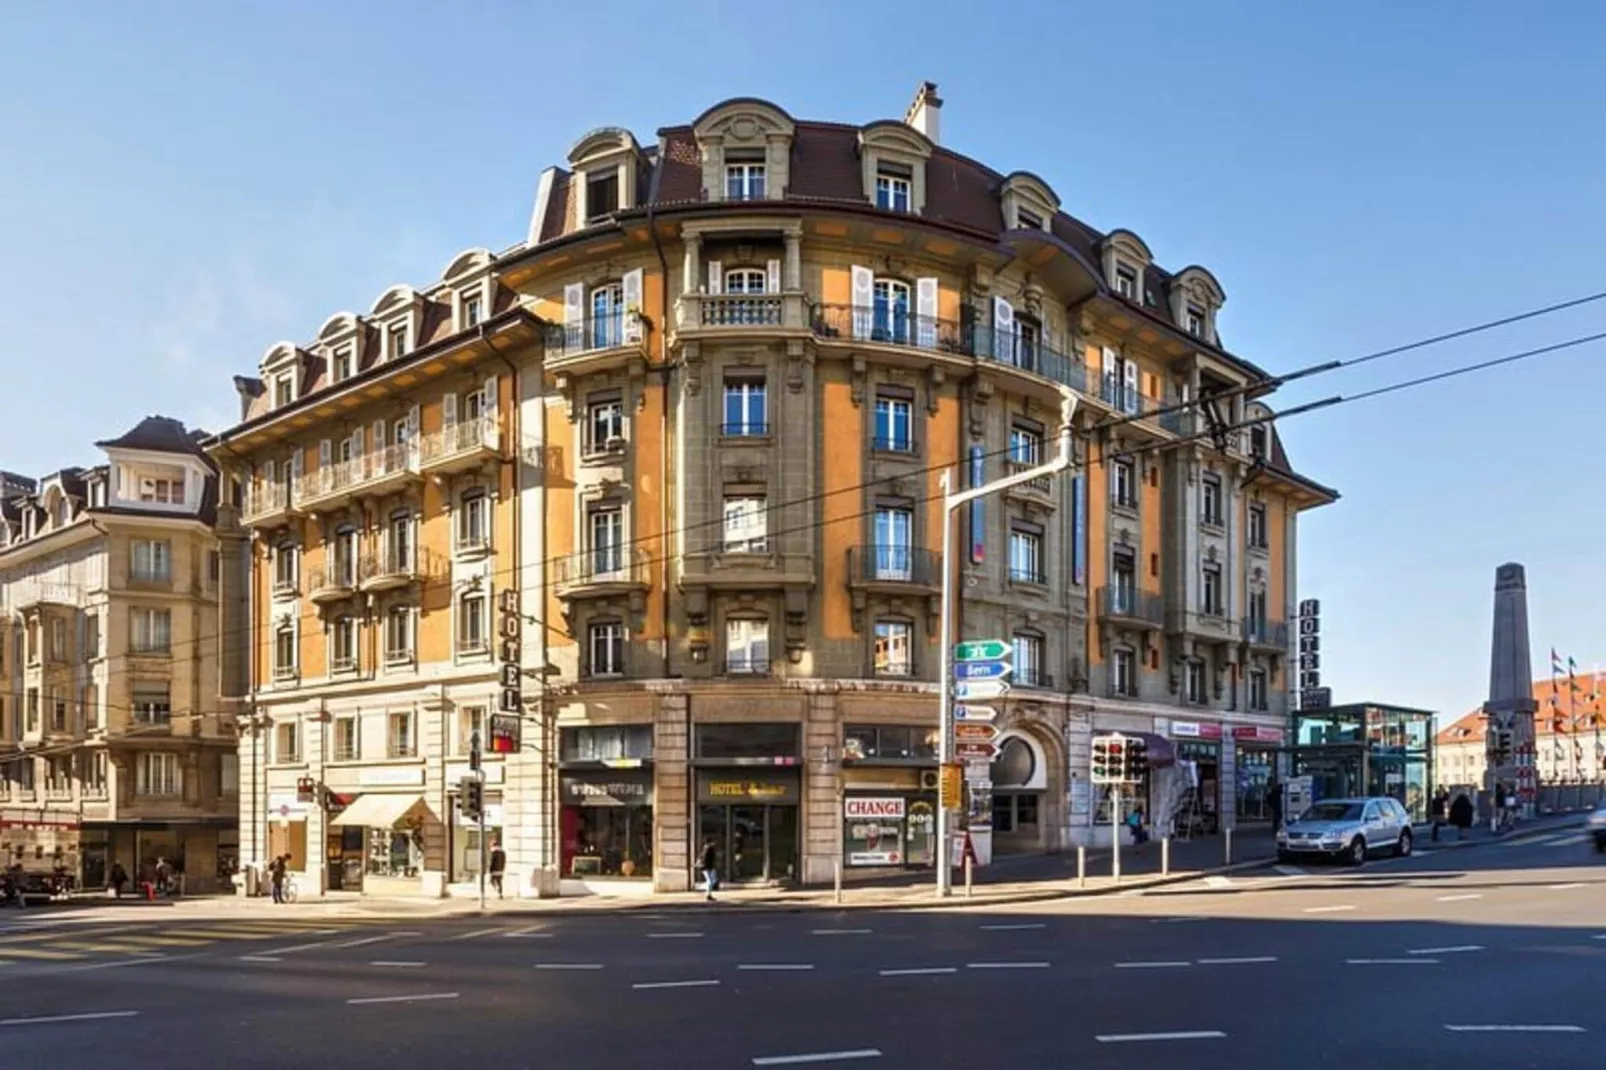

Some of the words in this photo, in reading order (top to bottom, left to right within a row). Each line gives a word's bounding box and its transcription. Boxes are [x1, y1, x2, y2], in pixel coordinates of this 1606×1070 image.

[506, 591, 518, 711] HOTEL
[1303, 601, 1315, 689] HOTEL
[710, 783, 744, 796] HOTEL
[847, 801, 902, 815] CHANGE
